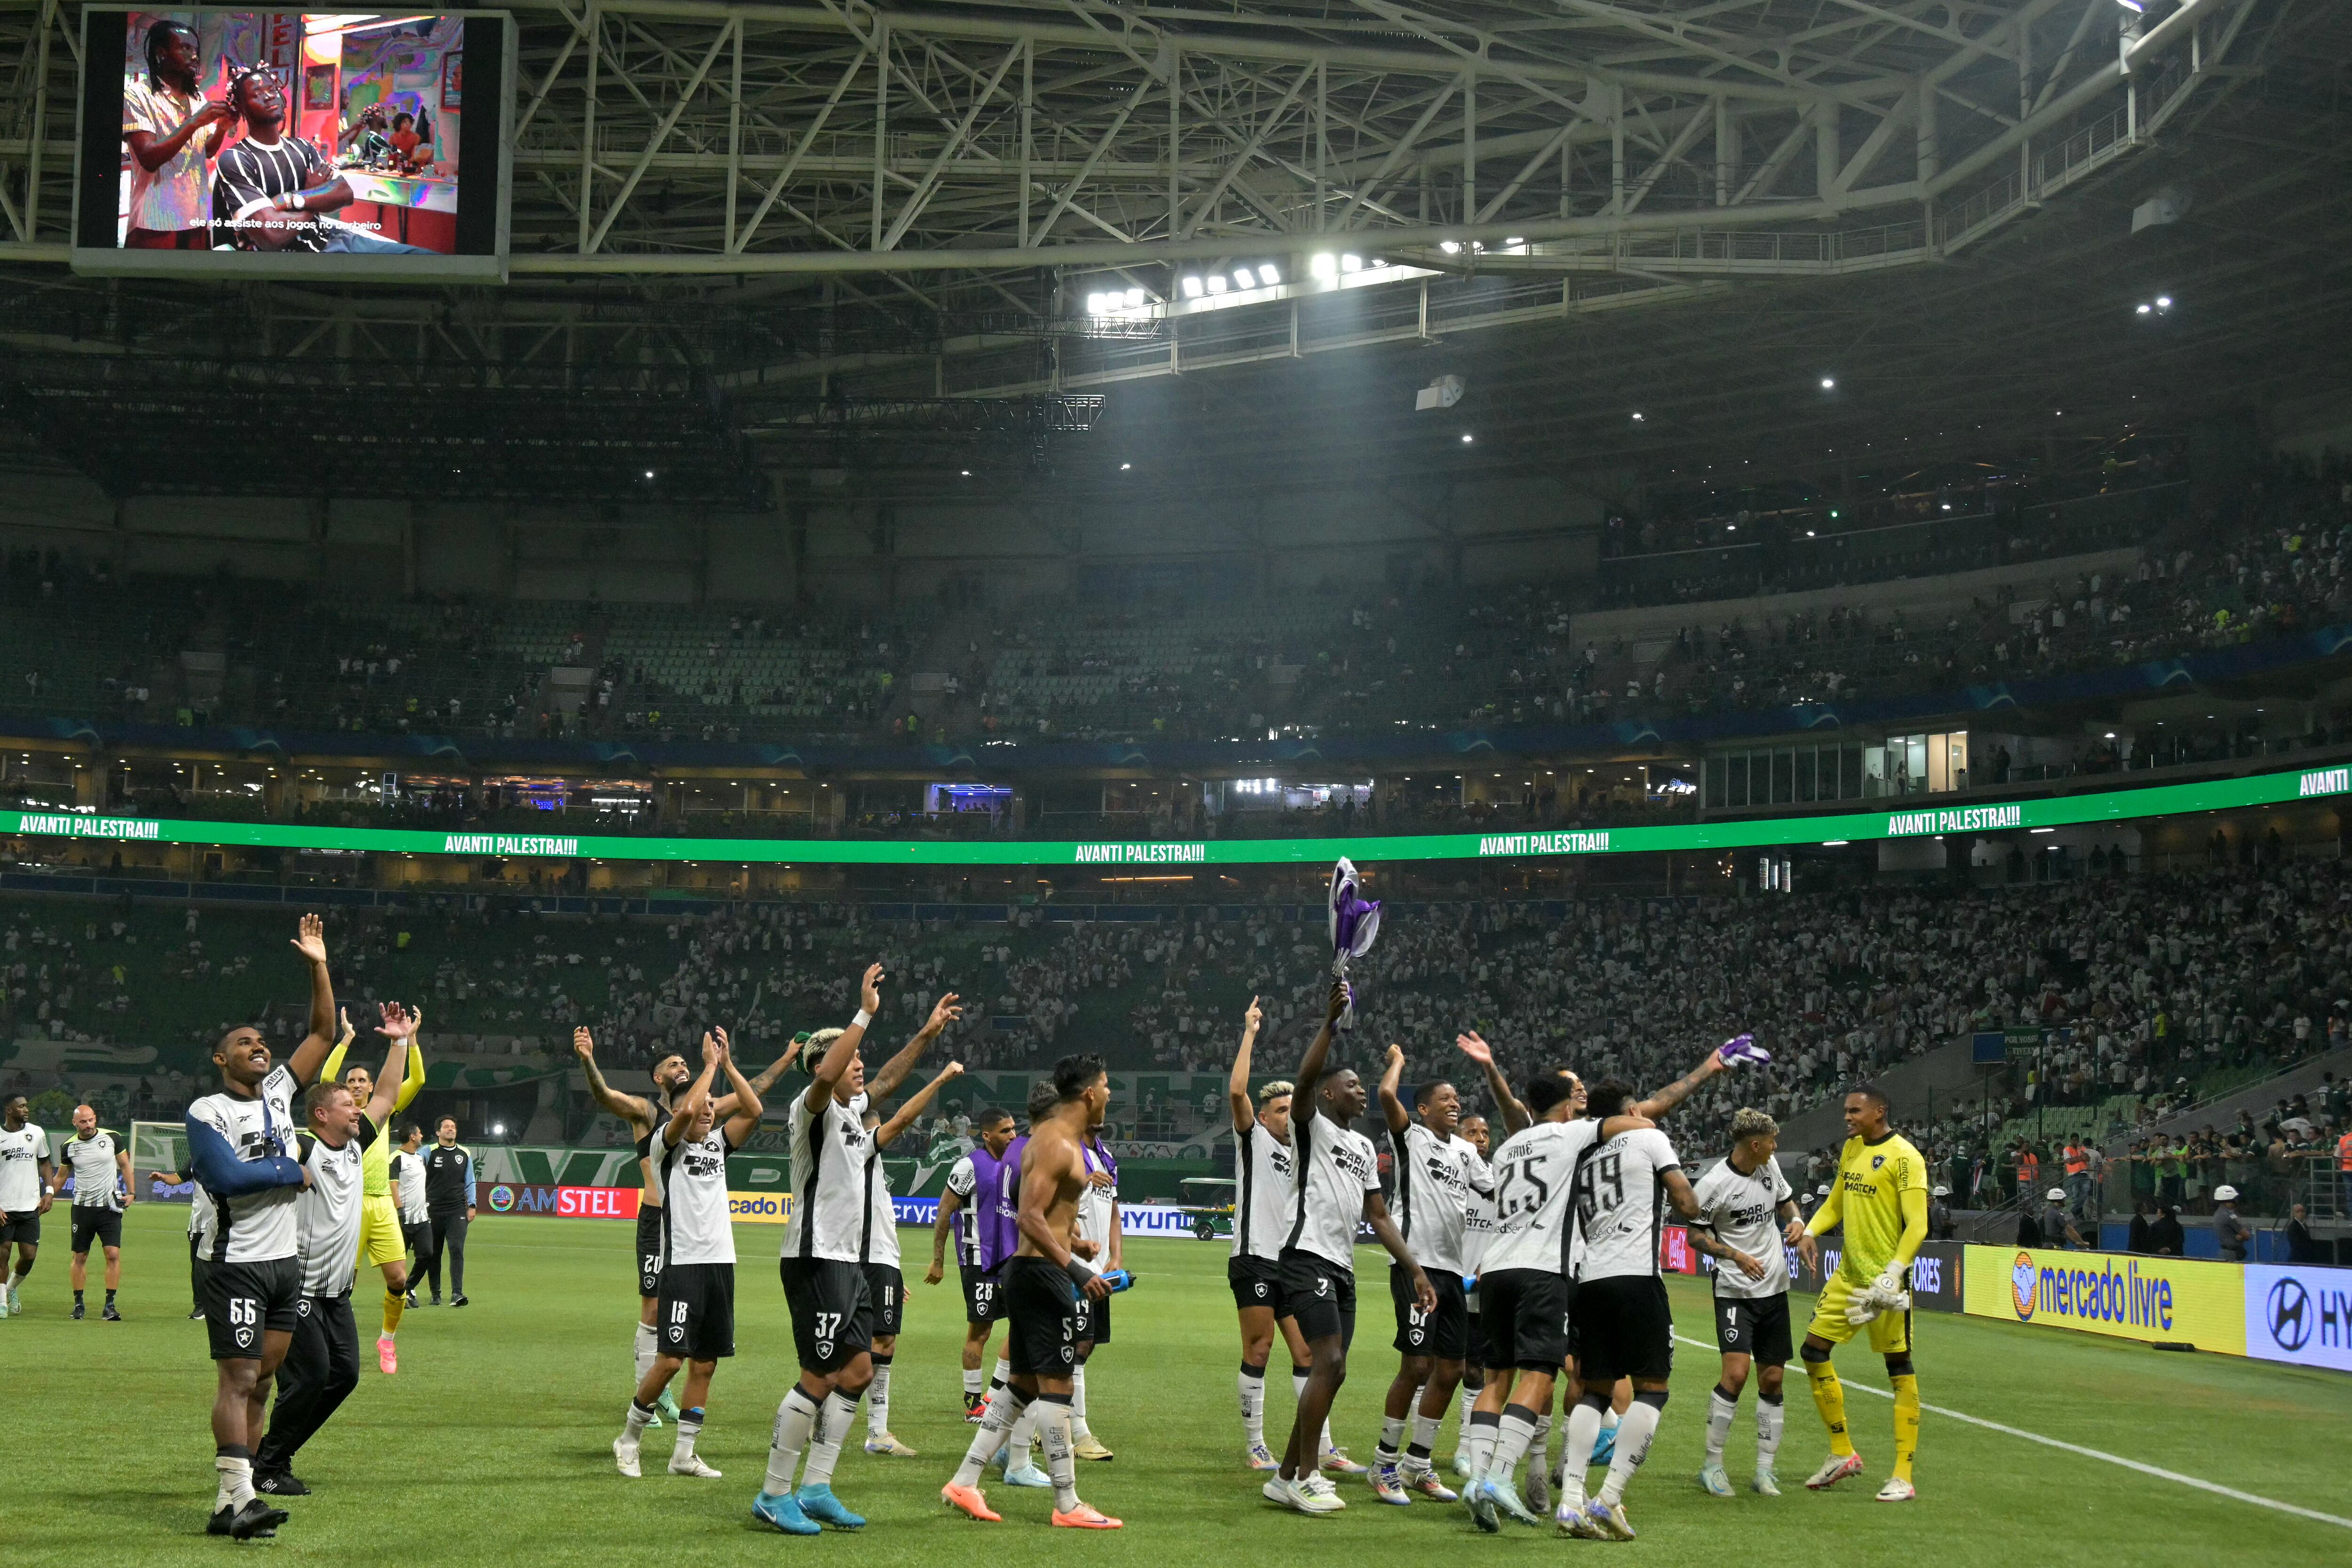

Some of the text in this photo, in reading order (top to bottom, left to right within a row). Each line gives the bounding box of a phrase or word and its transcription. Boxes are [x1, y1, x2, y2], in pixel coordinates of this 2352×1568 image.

[208, 218, 222, 227] só
[224, 219, 262, 228] assiste
[286, 220, 316, 230] jogos
[335, 221, 381, 230] barbeiro
[2300, 769, 2348, 796] AVANTI
[20, 815, 158, 839] AVANTI PALESTRA!!!
[1888, 806, 2020, 835] AVANTI PALESTRA!!!
[445, 836, 577, 855] AVANTI PALESTRA!!!
[1075, 844, 1205, 861] AVANTI PALESTRA!!!
[1480, 833, 1609, 855] AVANTI PALESTRA!!!
[1, 1147, 24, 1156] PARI
[683, 1155, 719, 1167] PARI
[1331, 1145, 1366, 1168] PARI
[1507, 1141, 1532, 1161] KAUÊ
[688, 1164, 723, 1177] MATC
[1335, 1157, 1368, 1182] MATC
[1843, 1172, 1864, 1182] PARI
[957, 1169, 974, 1194] Centrum
[1498, 1155, 1548, 1220] 25
[1577, 1153, 1626, 1222] 99
[1844, 1182, 1877, 1195] MATCH
[516, 1188, 621, 1215] AMSTEL
[1730, 1202, 1764, 1218] PARI
[976, 1282, 993, 1301] 28
[2040, 1258, 2173, 1331] mercado livre
[230, 1298, 256, 1325] 66
[671, 1301, 688, 1324] 18
[1727, 1306, 1736, 1326] 4
[815, 1312, 842, 1339] 37
[1062, 1317, 1073, 1341] 5
[1049, 1426, 1067, 1451] Lifefit
